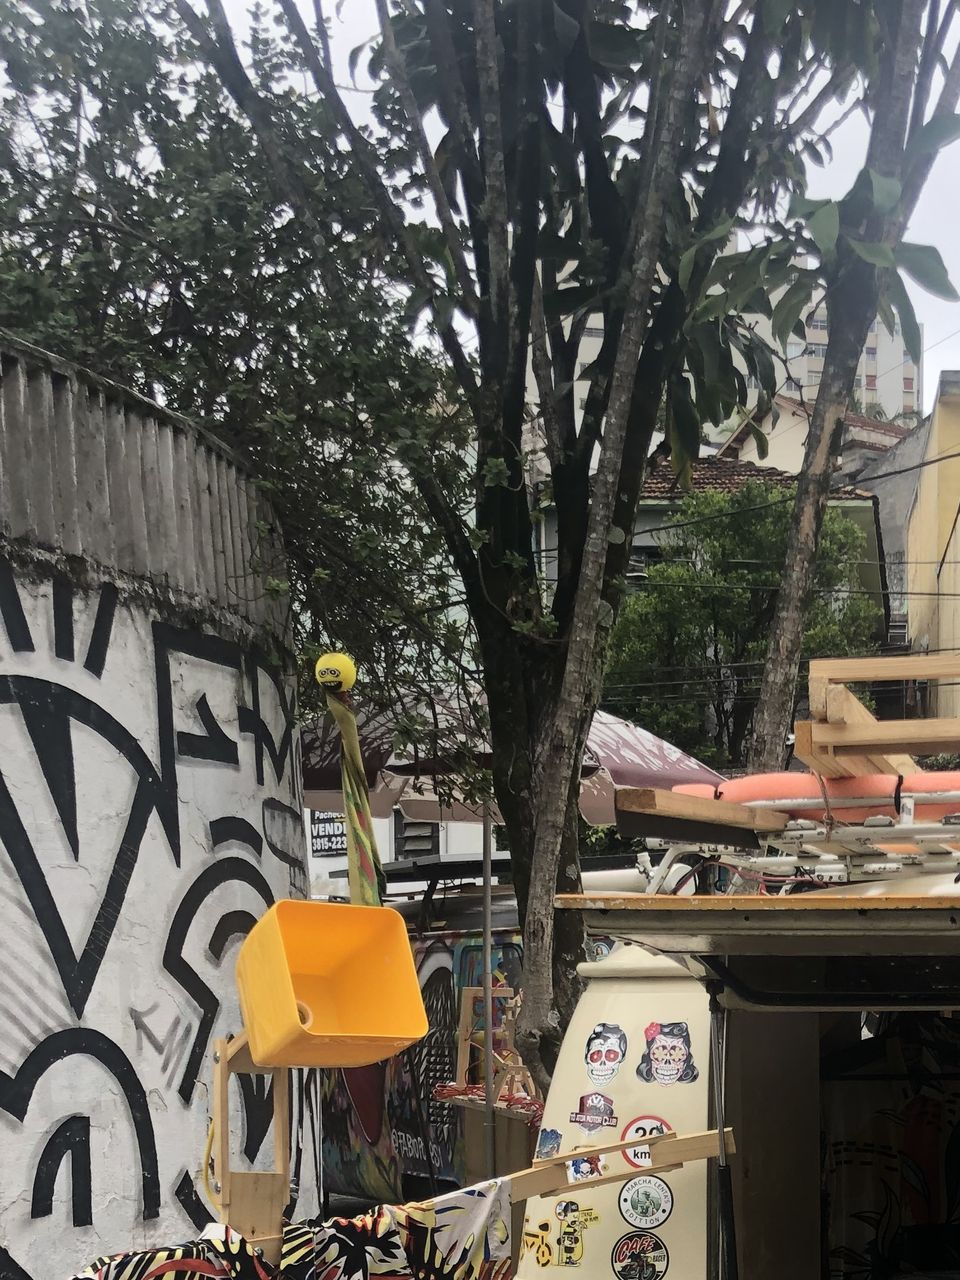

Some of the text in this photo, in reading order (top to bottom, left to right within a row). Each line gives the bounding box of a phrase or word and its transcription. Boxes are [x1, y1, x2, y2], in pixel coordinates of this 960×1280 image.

[311, 822, 347, 837] VEND
[312, 836, 347, 851] 3815-223
[626, 1178, 652, 1194] MARCHA
[624, 1208, 661, 1225] EDITION
